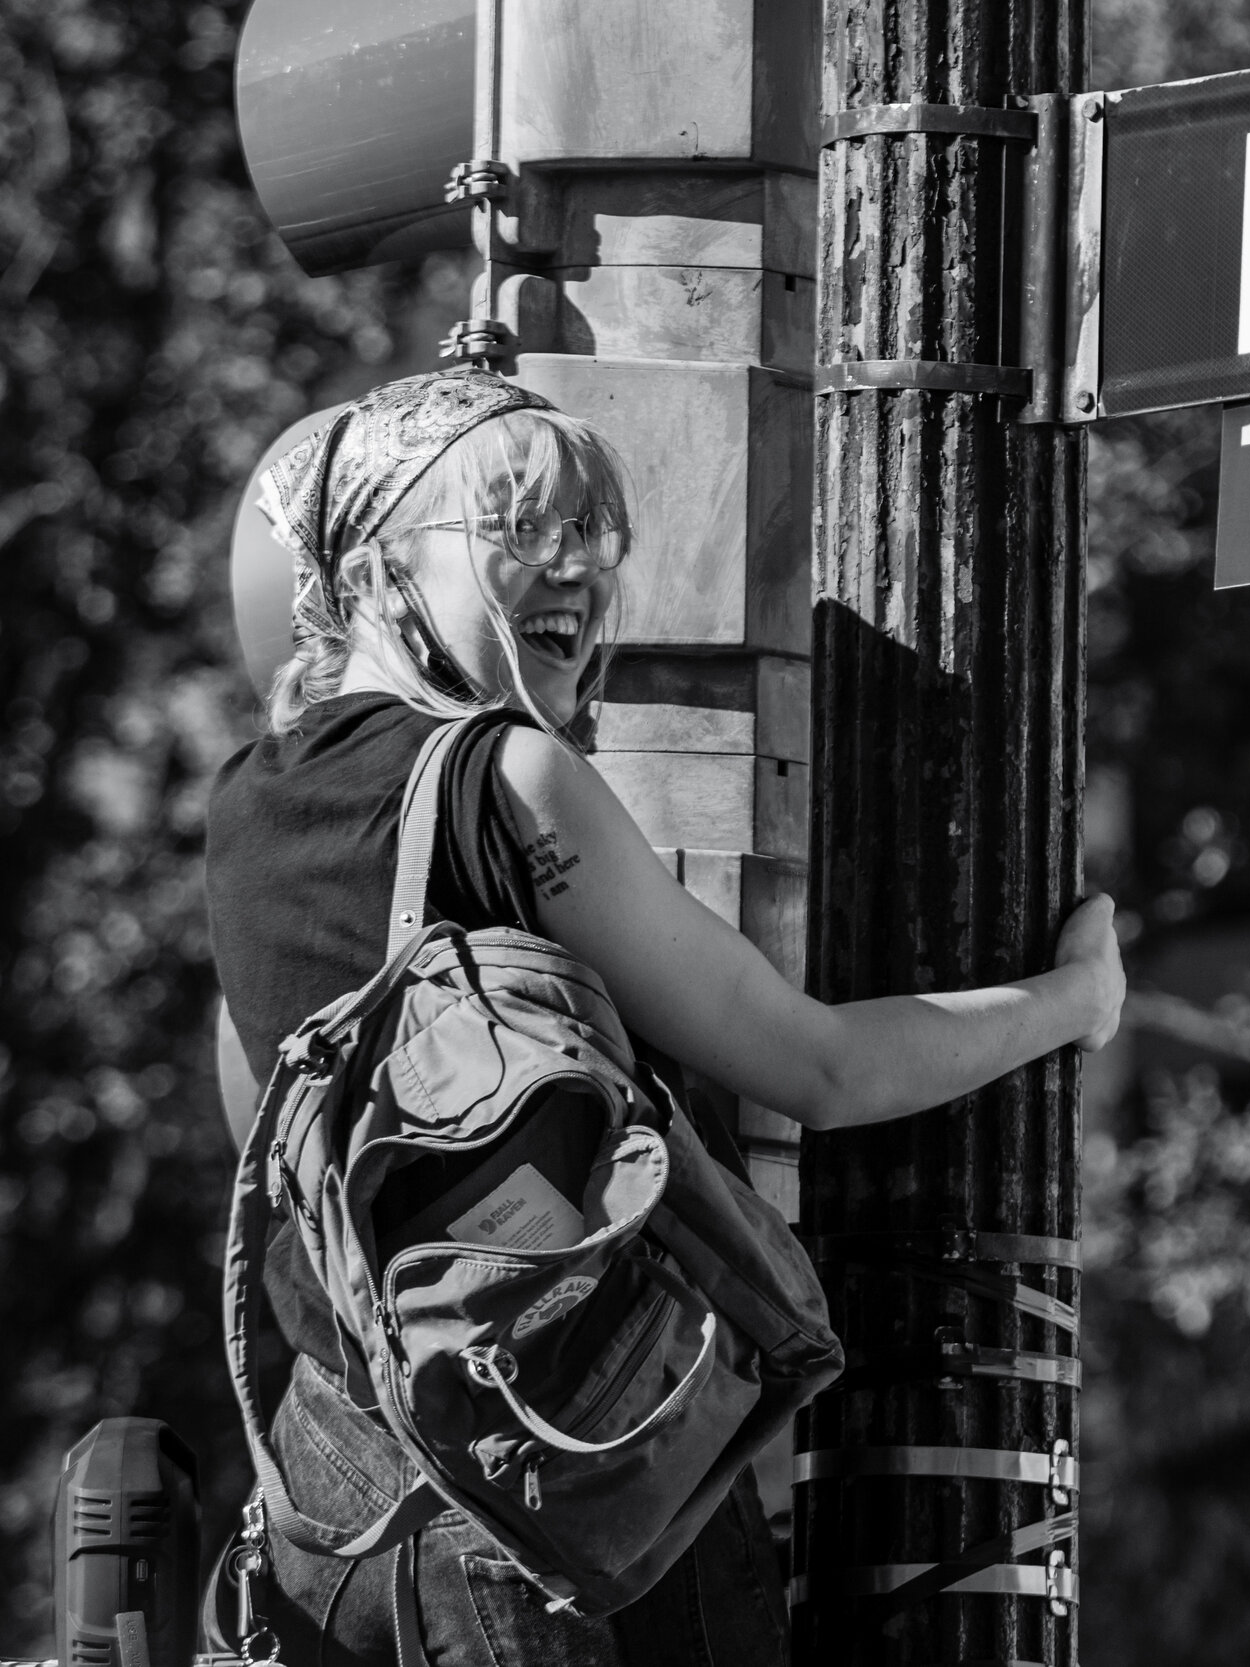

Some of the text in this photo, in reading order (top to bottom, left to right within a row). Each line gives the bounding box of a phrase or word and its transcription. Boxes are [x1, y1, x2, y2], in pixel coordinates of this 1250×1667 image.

[536, 831, 557, 848] sky
[534, 850, 559, 866] big
[533, 854, 580, 887] and here
[550, 881, 569, 896] am
